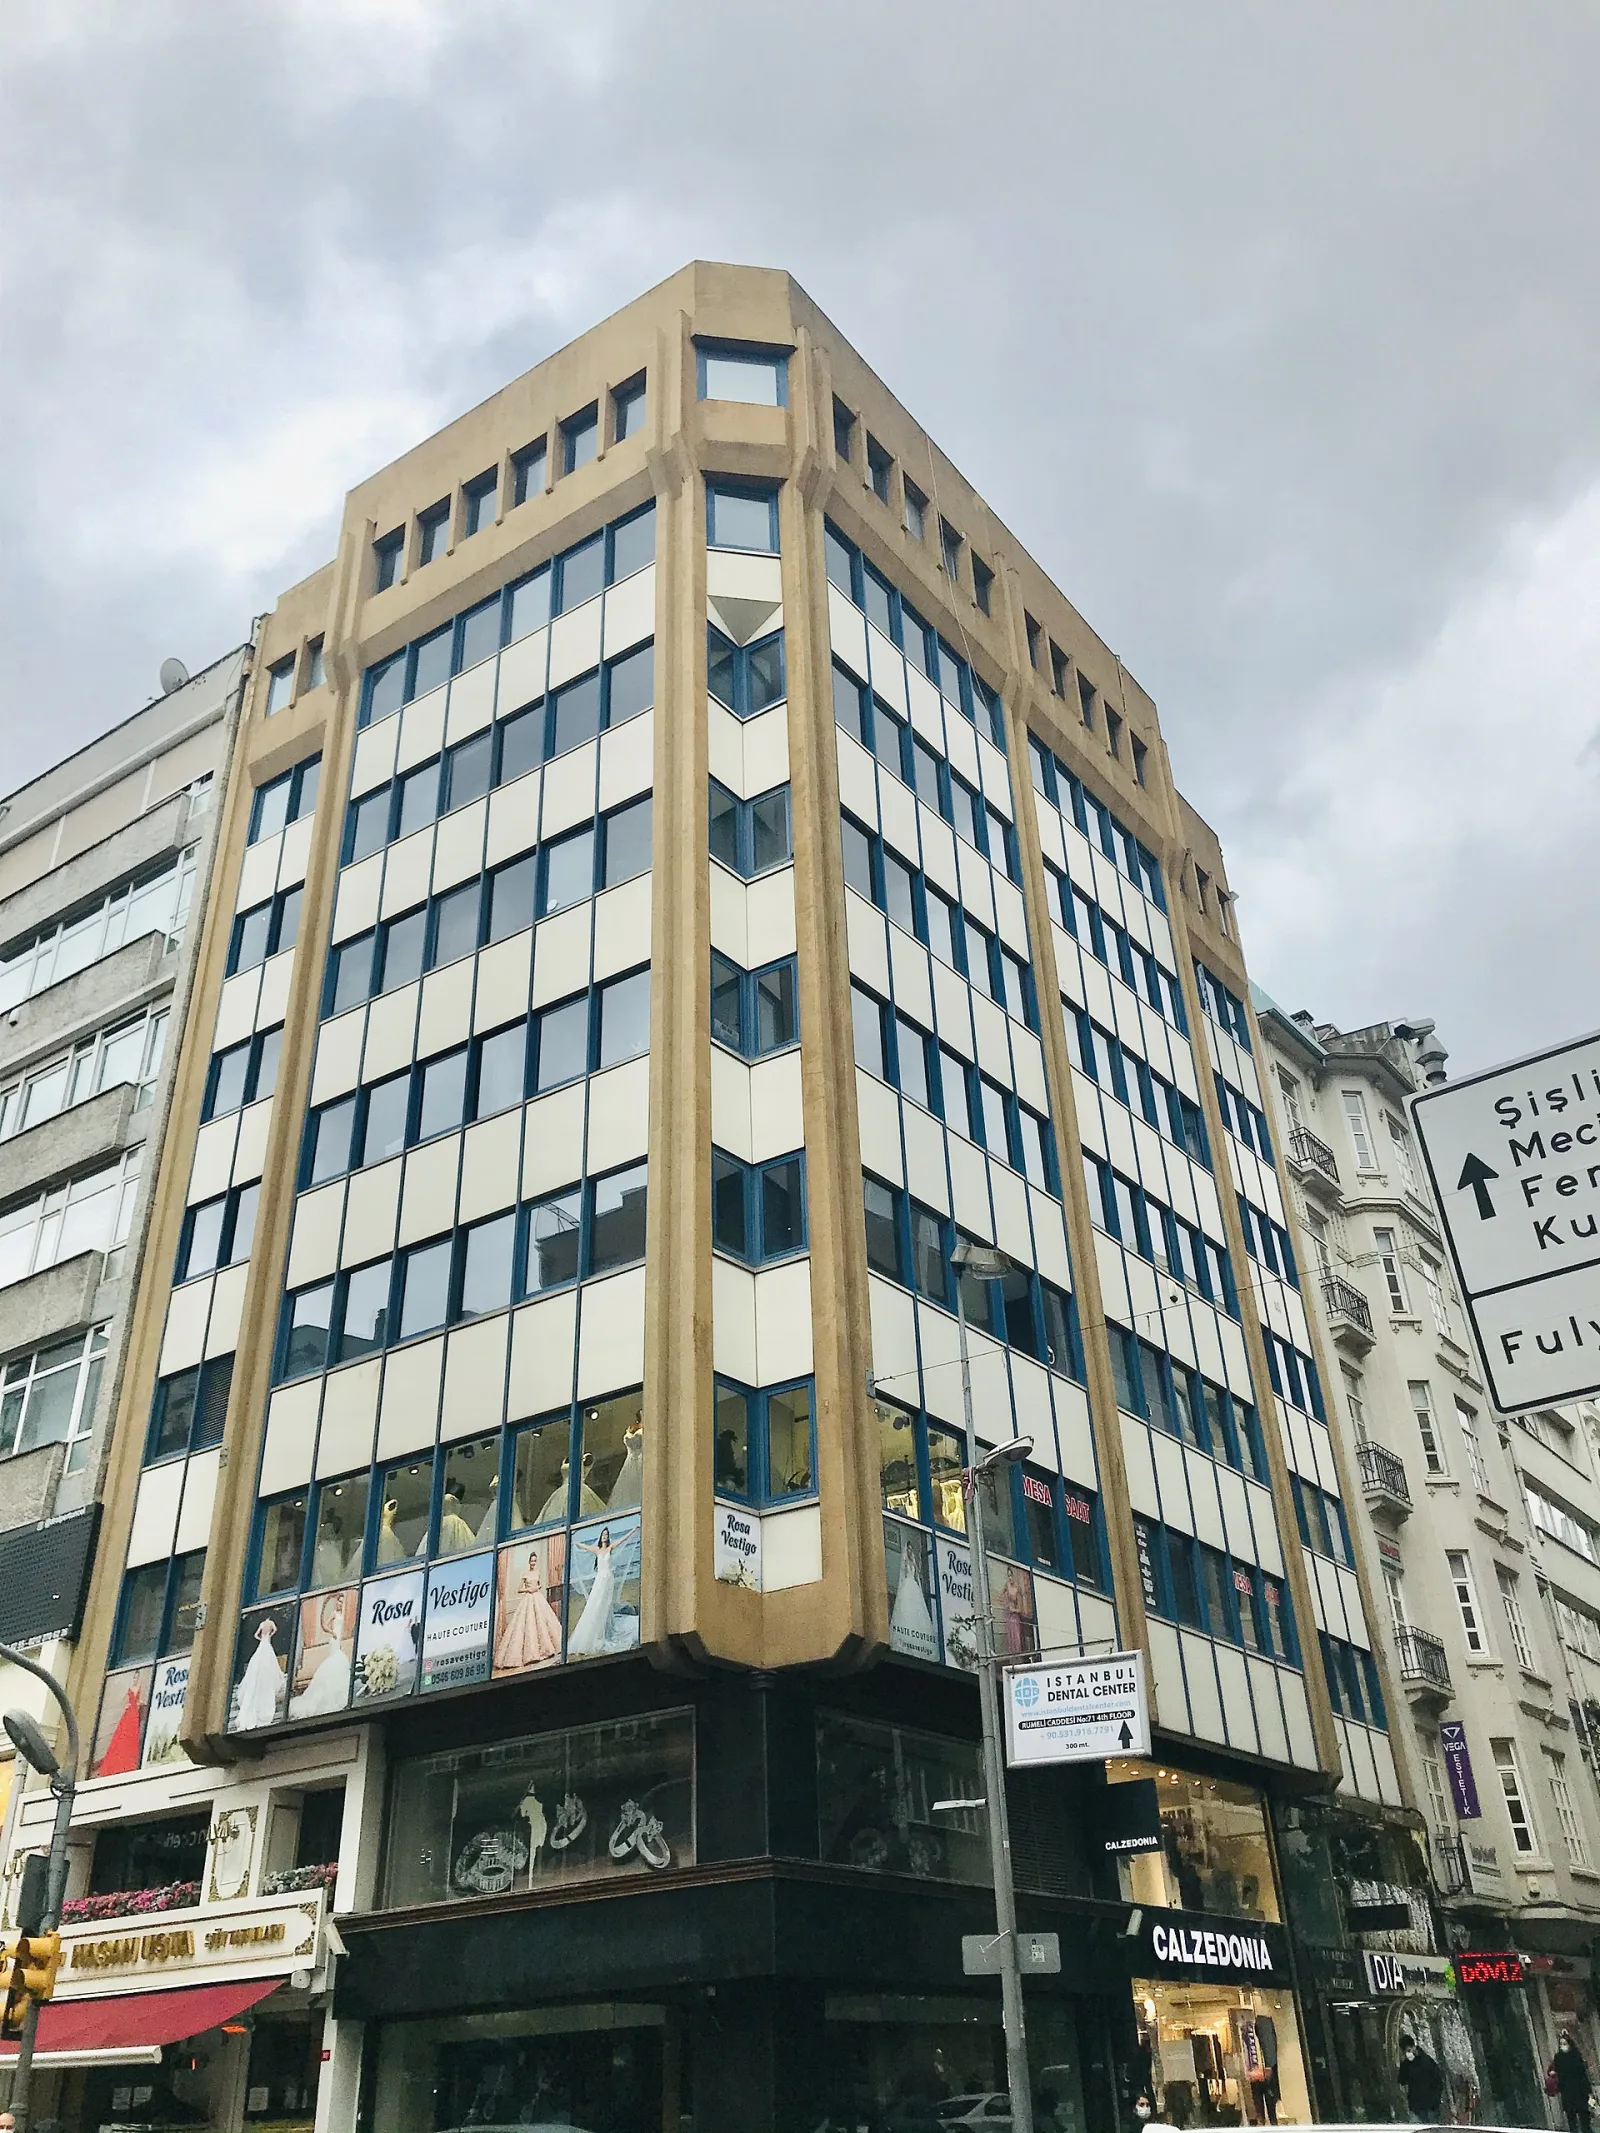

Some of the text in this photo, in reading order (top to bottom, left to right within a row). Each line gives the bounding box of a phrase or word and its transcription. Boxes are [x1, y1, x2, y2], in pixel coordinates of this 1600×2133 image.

[1494, 1069, 1600, 1130] Şişli
[1022, 1474, 1090, 1524] MESA SAAT
[727, 1514, 751, 1535] Rosa
[721, 1530, 757, 1556] Vestigo
[371, 1580, 490, 1626] Rosa Vestigo
[427, 1620, 488, 1641] HAUTE COUTURE
[1046, 1667, 1135, 1688] ISTANBUL
[155, 1686, 187, 1710] Vesti
[1047, 1682, 1136, 1702] DENTAL CENTER
[1020, 1700, 1131, 1718] www.istanbuldentalcenter.com
[1076, 1714, 1095, 1723] No:71
[1096, 1713, 1108, 1722] 4th
[1109, 1711, 1133, 1720] FLOOR
[1443, 1742, 1466, 1752] VEGA
[1105, 1836, 1158, 1850] CALZEDONIA
[1152, 1925, 1273, 1971] CALZEDONIA
